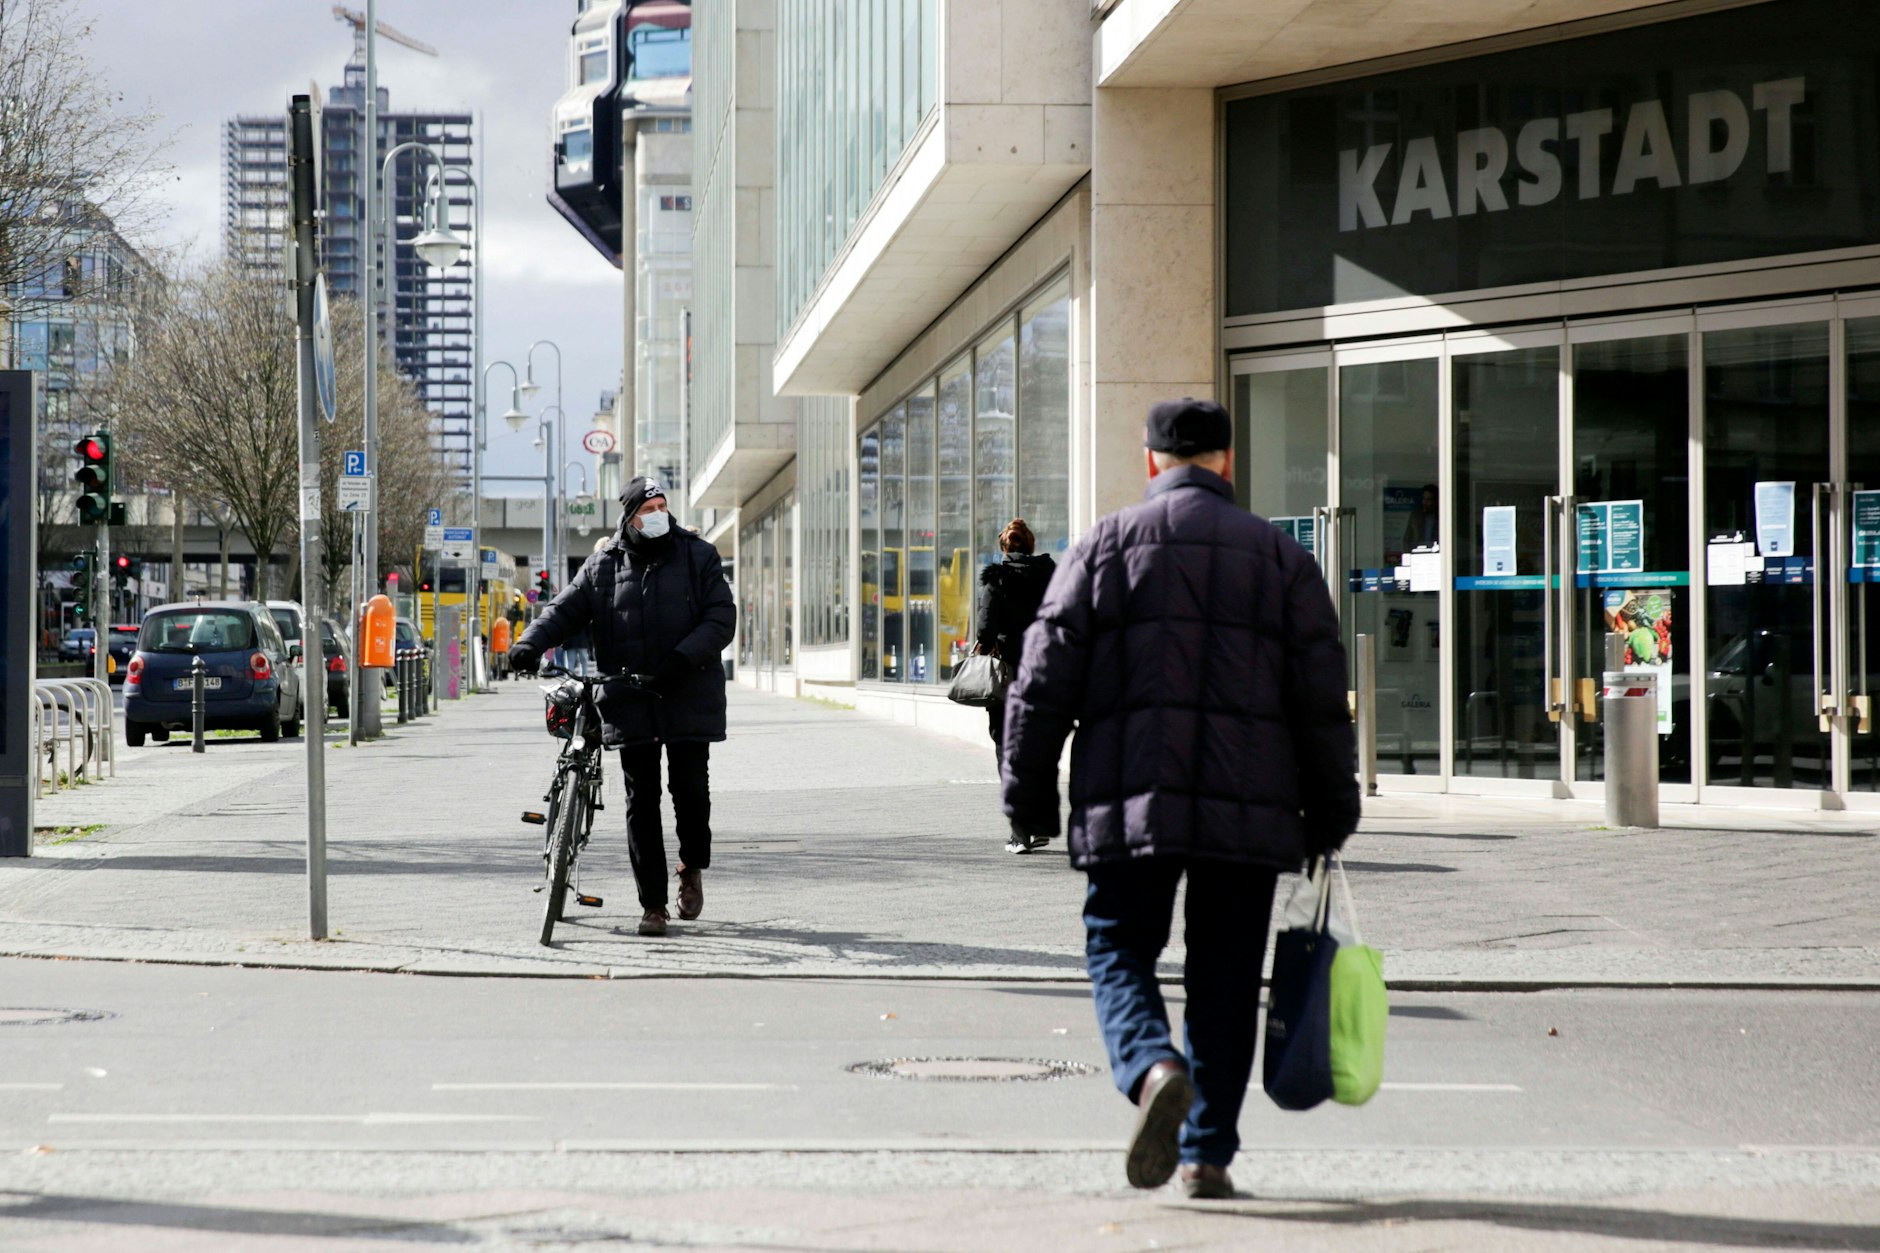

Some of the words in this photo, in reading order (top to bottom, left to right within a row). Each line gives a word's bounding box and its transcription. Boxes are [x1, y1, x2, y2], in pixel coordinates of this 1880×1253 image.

[1339, 75, 1806, 233] KARSTADT
[589, 437, 609, 449] C&A
[347, 454, 360, 474] P
[430, 511, 438, 525] P
